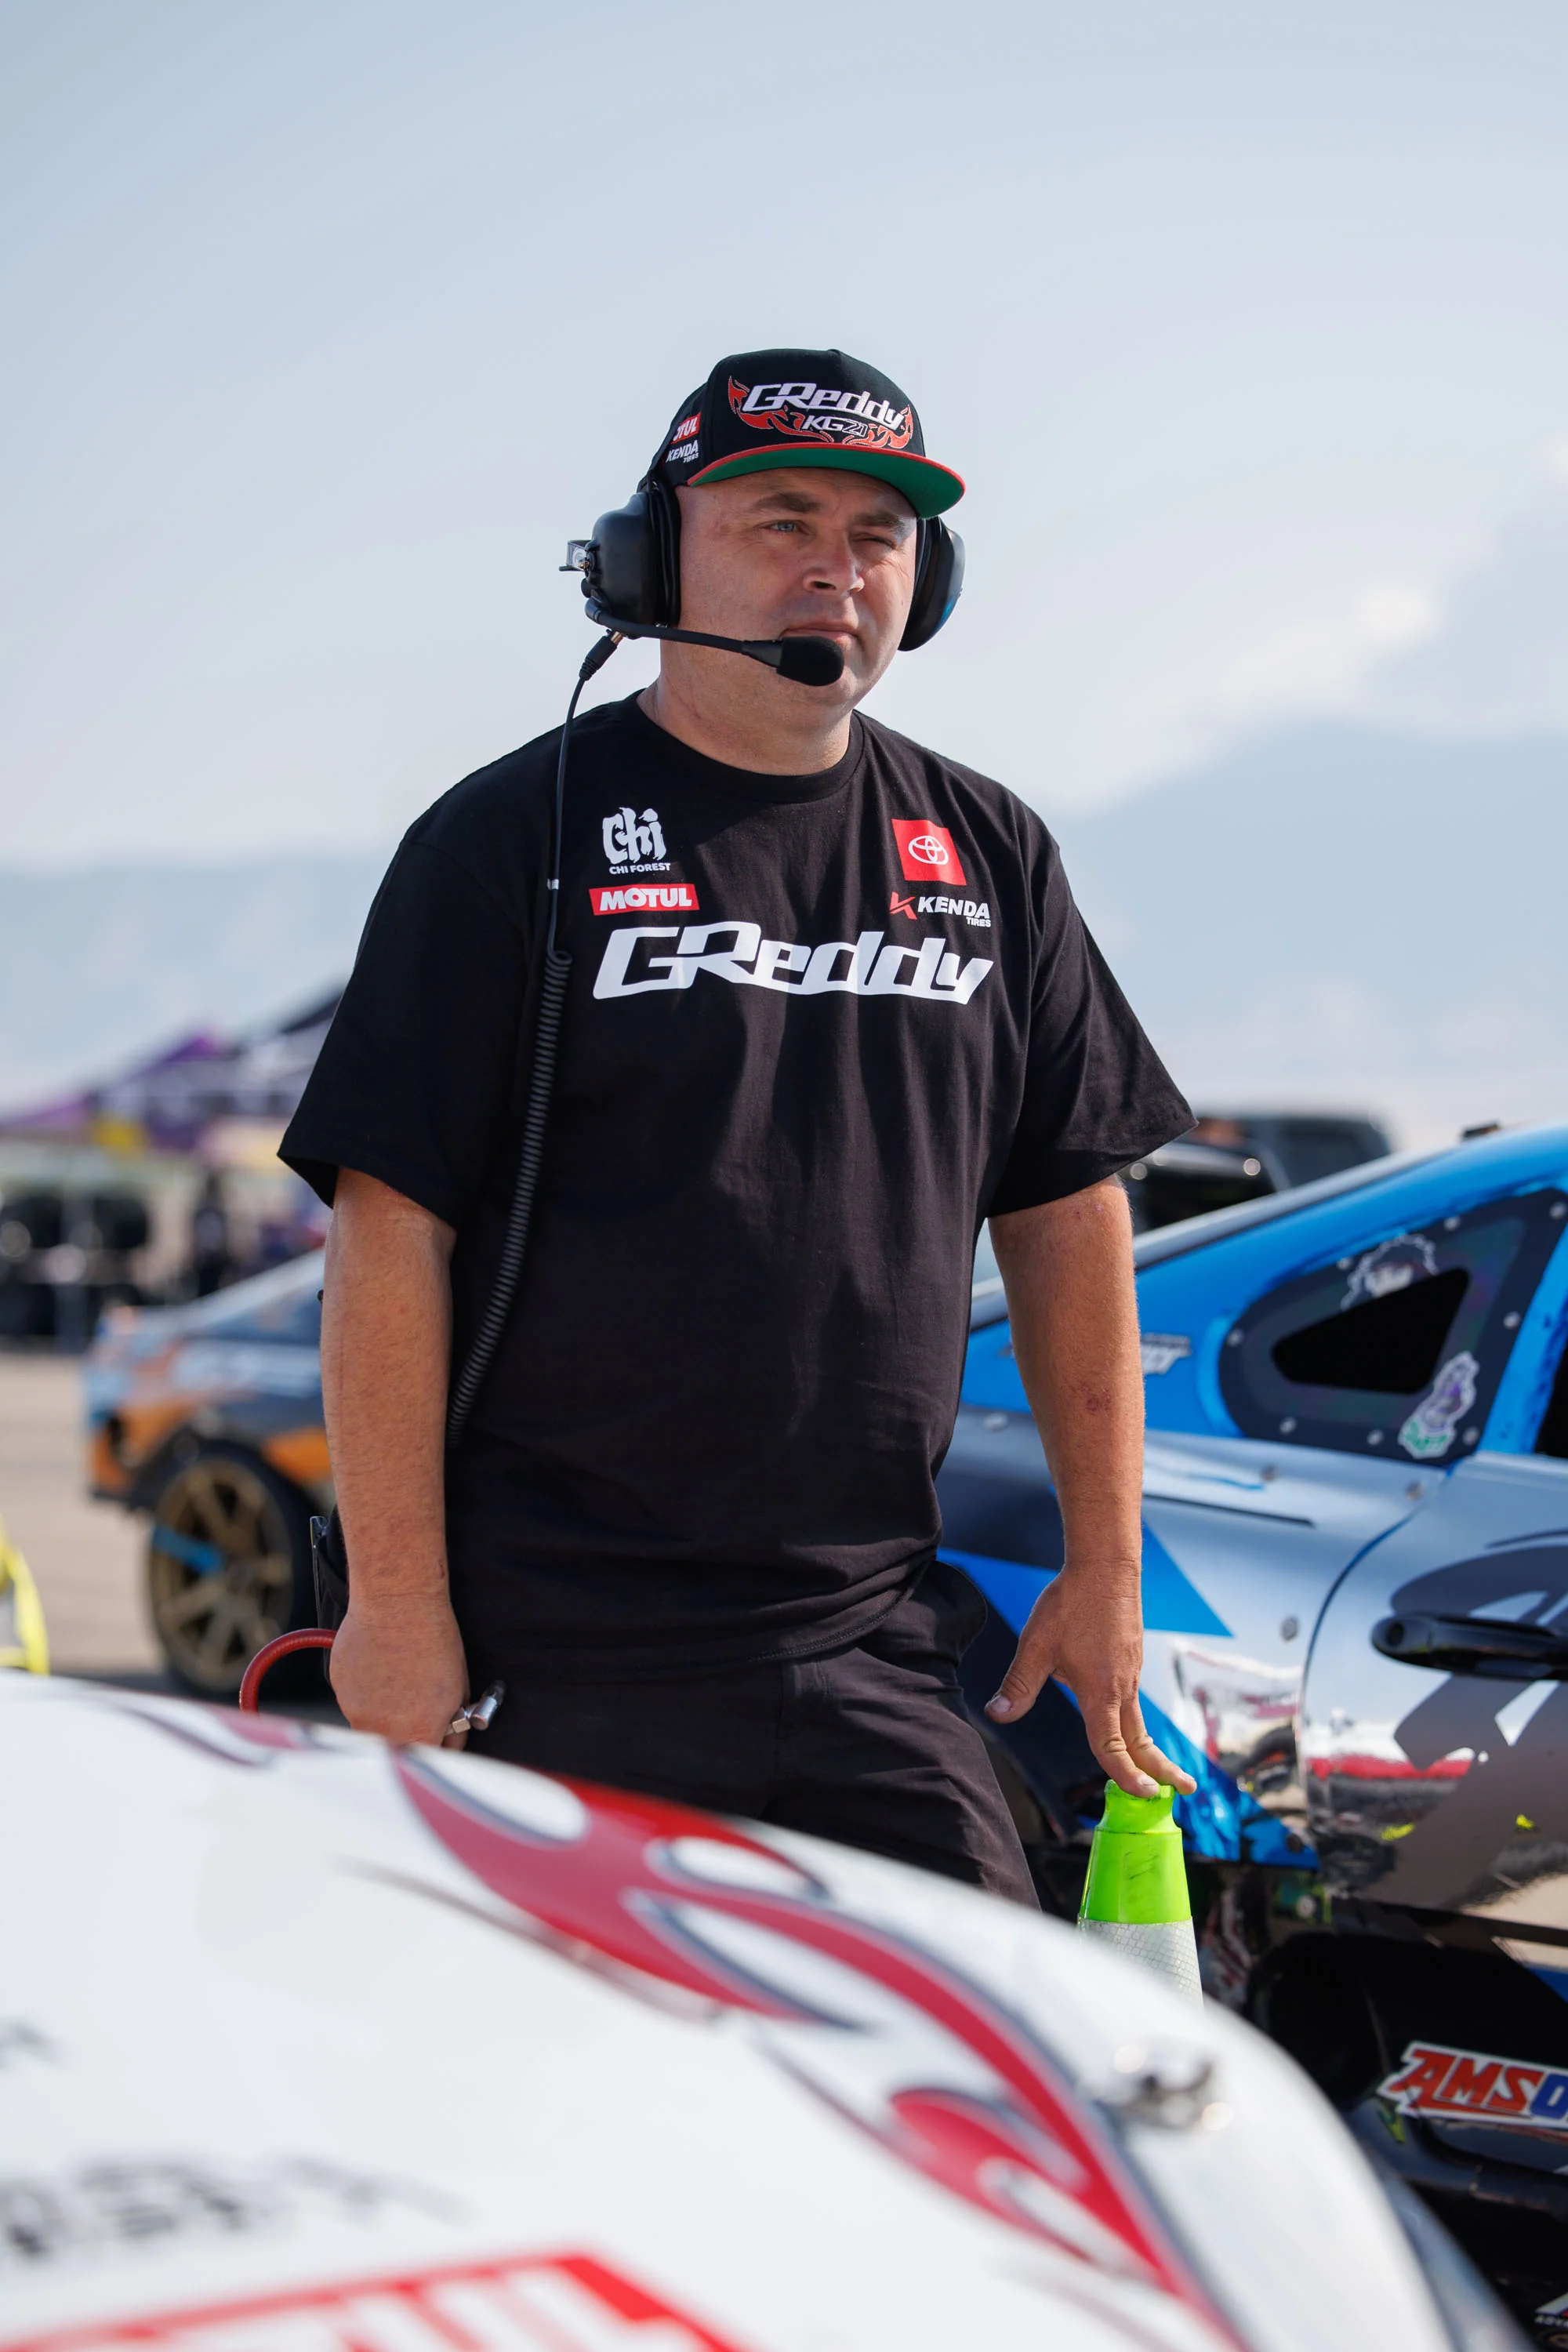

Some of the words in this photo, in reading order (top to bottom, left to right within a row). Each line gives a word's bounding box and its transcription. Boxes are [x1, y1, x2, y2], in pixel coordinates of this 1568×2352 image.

[742, 383, 906, 430] GReddy
[666, 439, 699, 463] KENDA
[608, 866, 629, 875] CHI
[630, 862, 671, 873] FOREST
[600, 887, 692, 912] MOTUL
[917, 896, 990, 920] KENDA
[966, 916, 992, 927] TIRES
[593, 920, 994, 1005] GReddy
